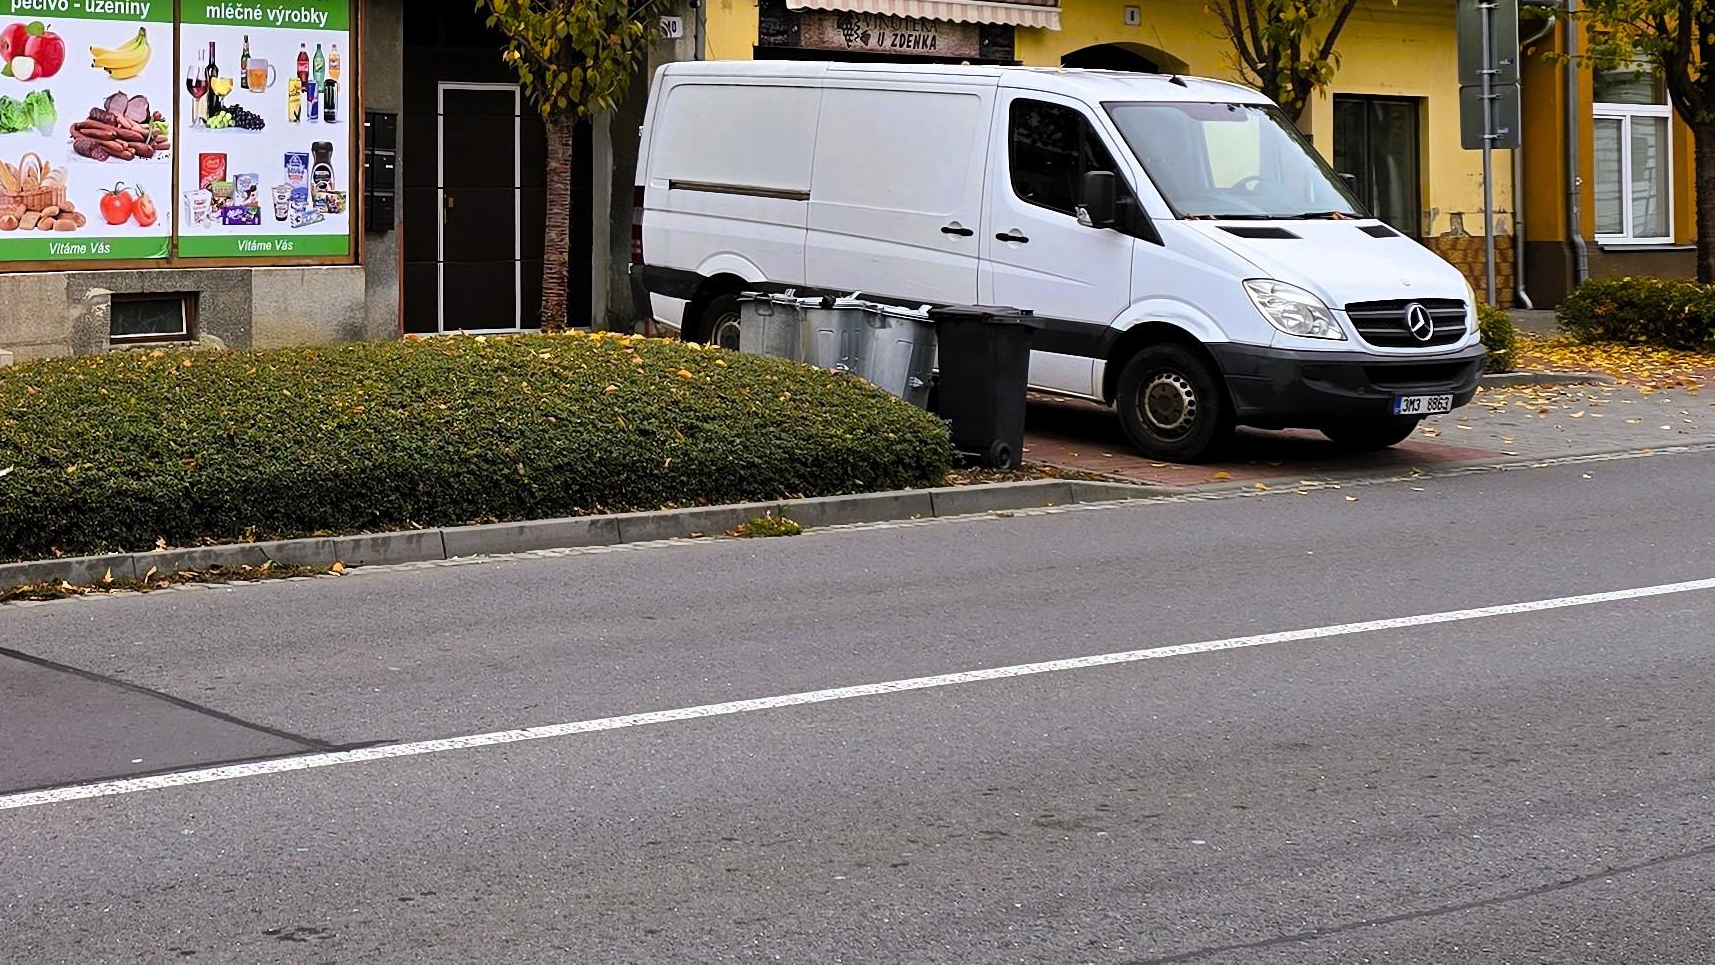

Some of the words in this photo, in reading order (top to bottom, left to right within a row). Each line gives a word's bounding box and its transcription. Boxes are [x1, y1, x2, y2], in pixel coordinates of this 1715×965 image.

[206, 1, 263, 20] mléčné
[267, 4, 328, 27] výrobky
[877, 32, 886, 48] U
[890, 33, 937, 50] ZDENKA
[49, 242, 87, 255] Vítáme
[90, 242, 111, 254] Vás
[237, 239, 272, 252] Vítáme
[275, 239, 294, 251] Vás
